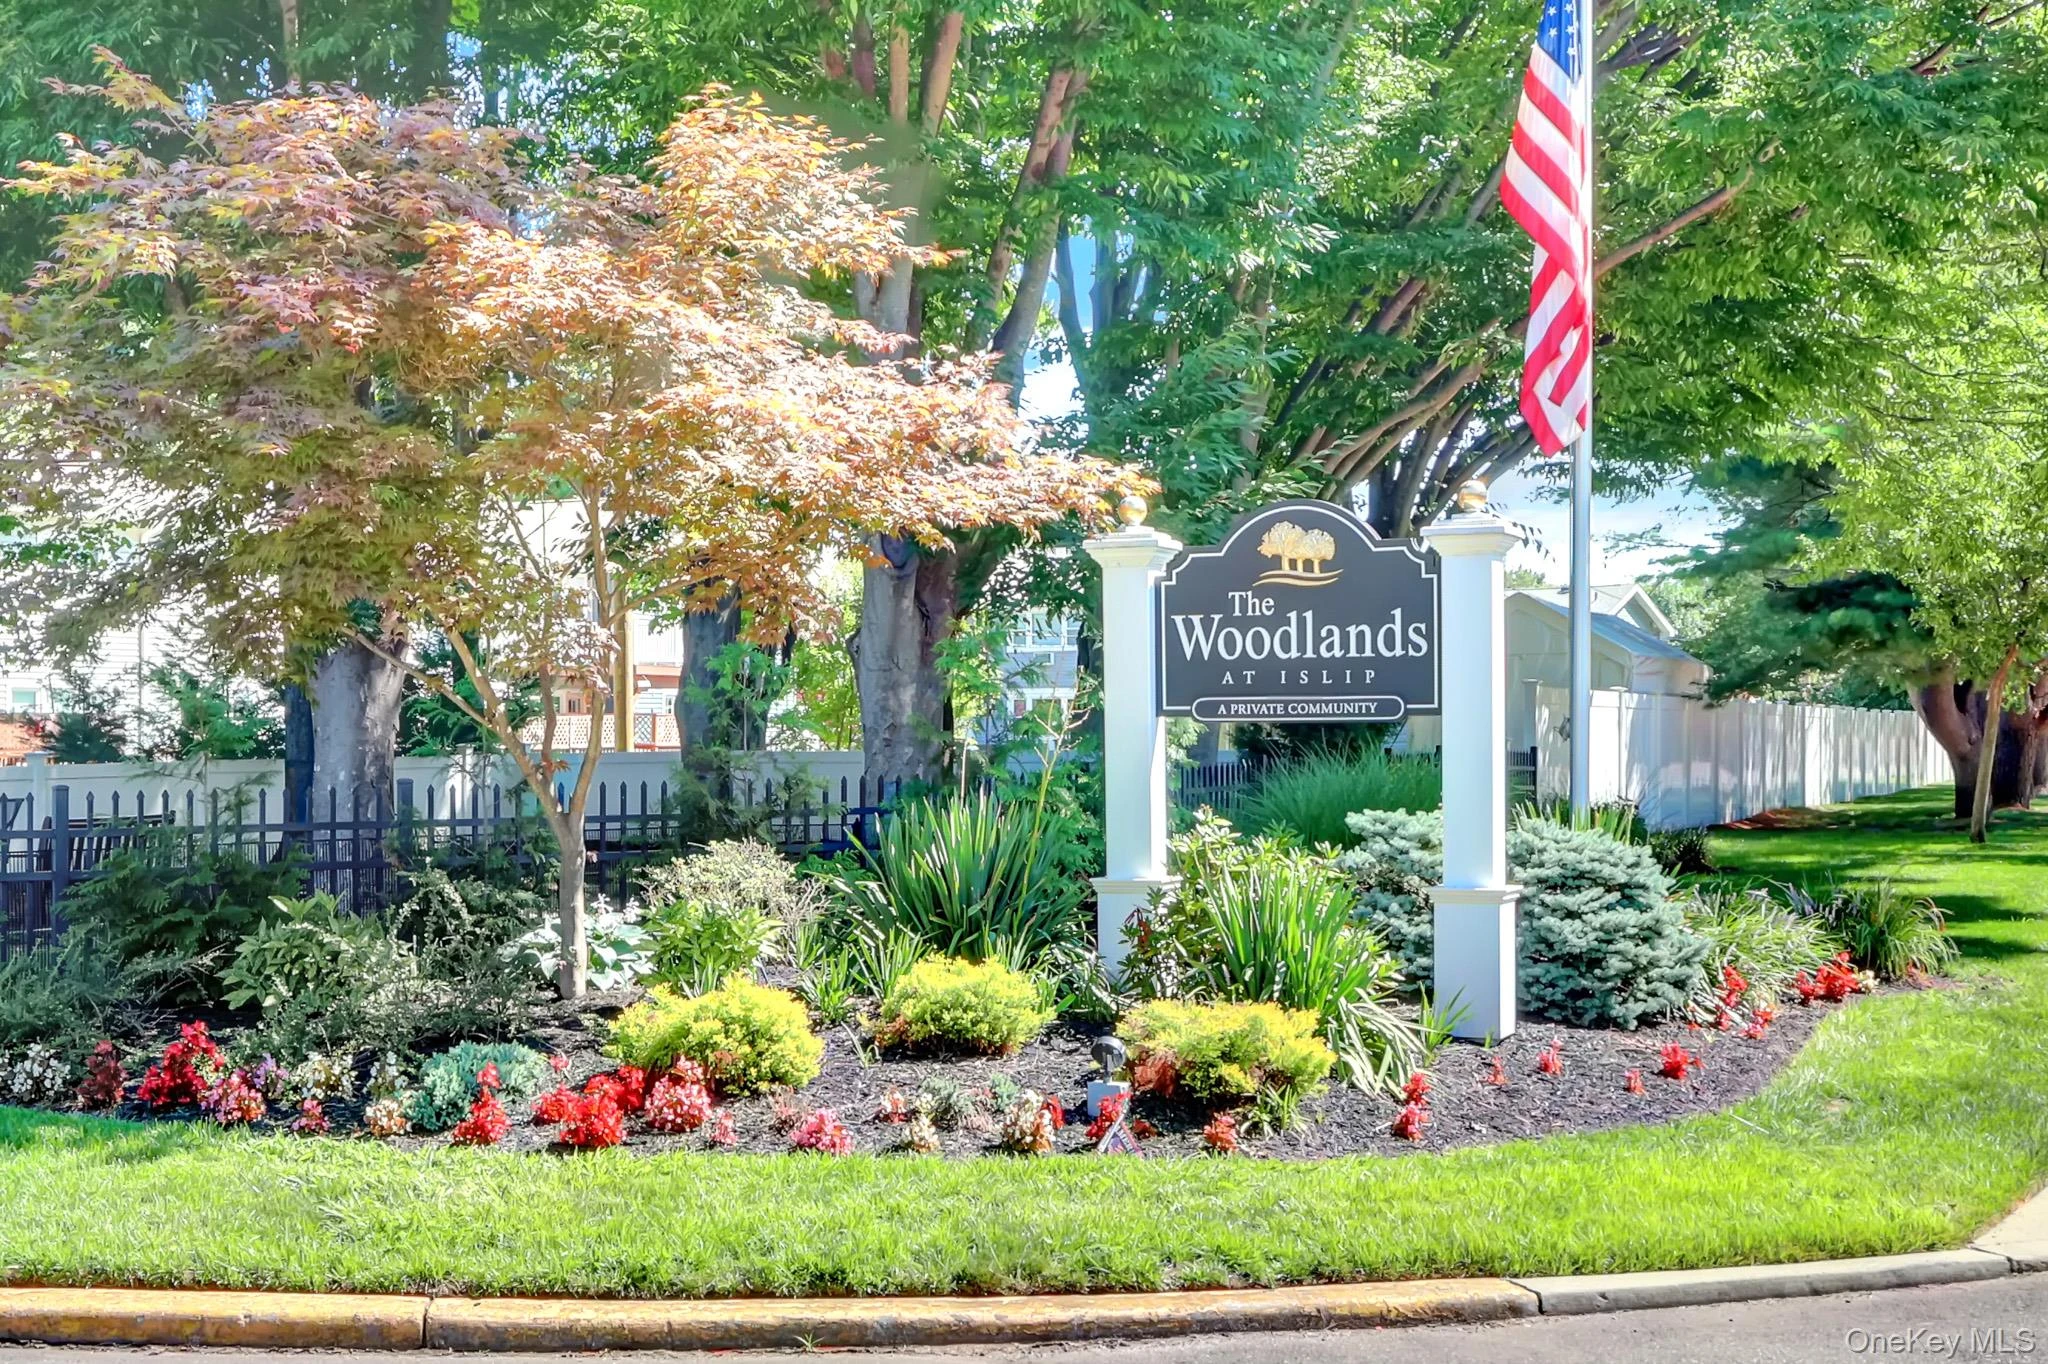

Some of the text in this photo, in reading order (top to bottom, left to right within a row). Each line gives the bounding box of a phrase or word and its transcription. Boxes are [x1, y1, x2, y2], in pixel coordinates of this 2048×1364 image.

[1228, 590, 1275, 616] The
[1171, 607, 1428, 661] Woodlands
[1222, 670, 1376, 685] AT ISLIP
[1217, 702, 1378, 715] A PRIVATE COMMUNITY
